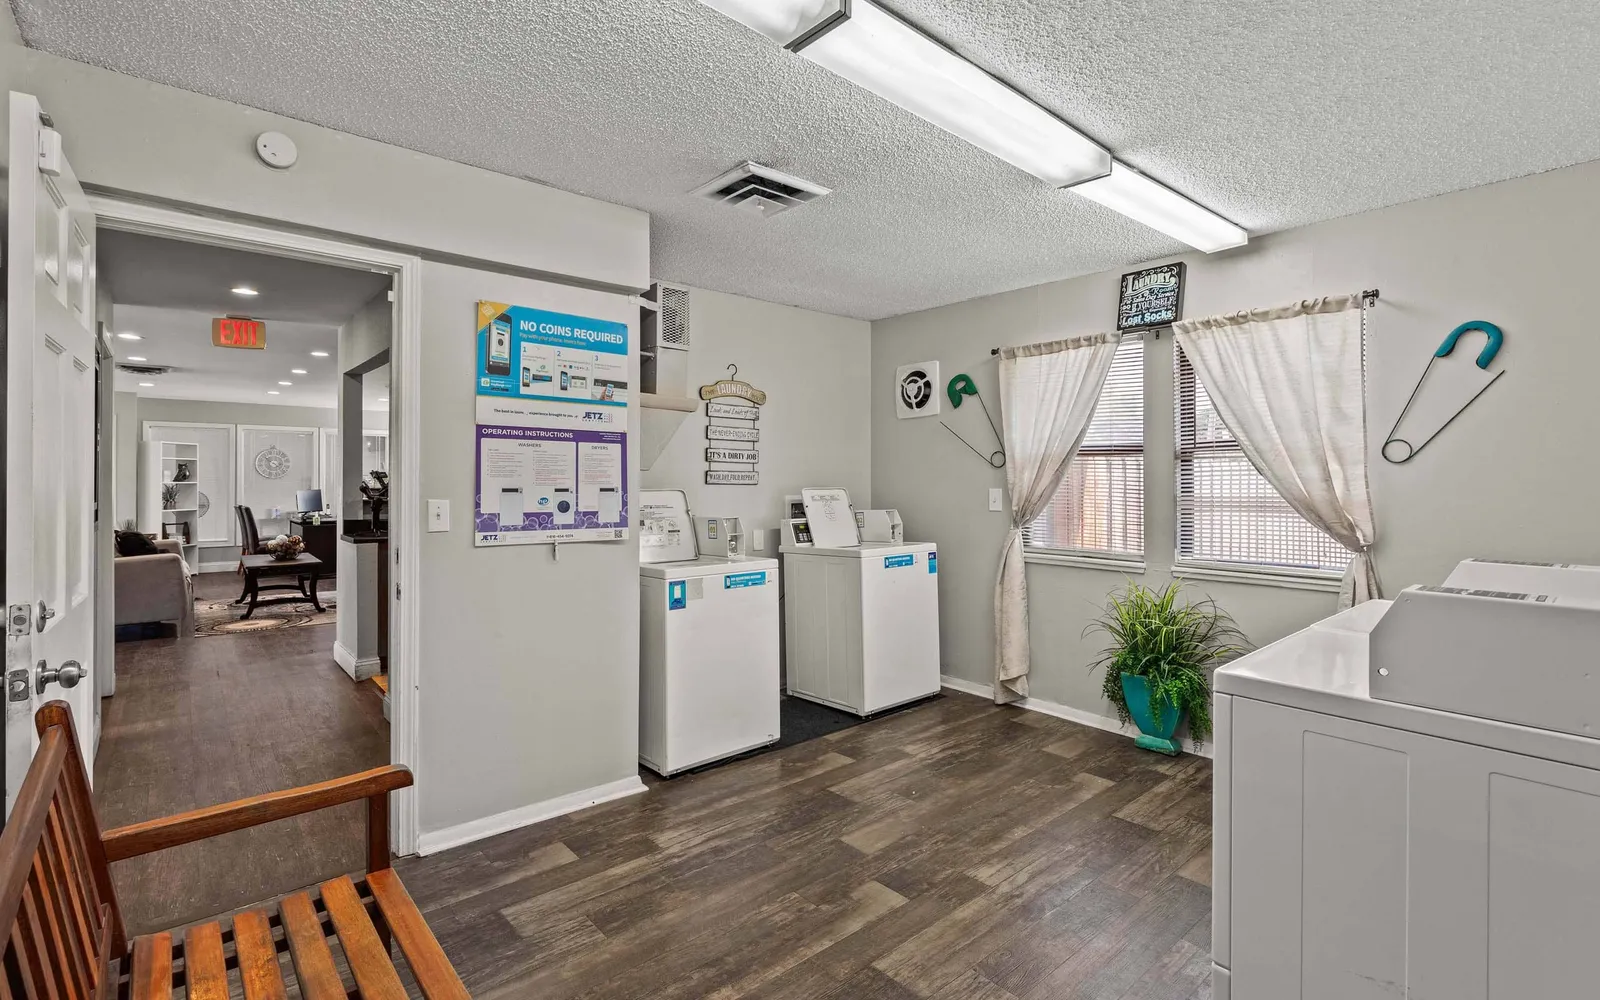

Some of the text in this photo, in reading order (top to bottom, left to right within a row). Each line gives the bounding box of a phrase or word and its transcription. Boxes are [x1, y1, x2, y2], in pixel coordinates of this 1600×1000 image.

[1125, 272, 1171, 295] LAUNDRY
[1122, 314, 1143, 326] Lost
[1144, 310, 1172, 322] Socks
[220, 320, 259, 345] EXIT
[520, 320, 624, 345] NO COINS REQUIRED
[717, 383, 753, 398] LAUNDRY
[582, 411, 603, 420] JETZ
[482, 427, 574, 439] OPERATING INSTRUCTIONS
[709, 451, 721, 459] IT'S
